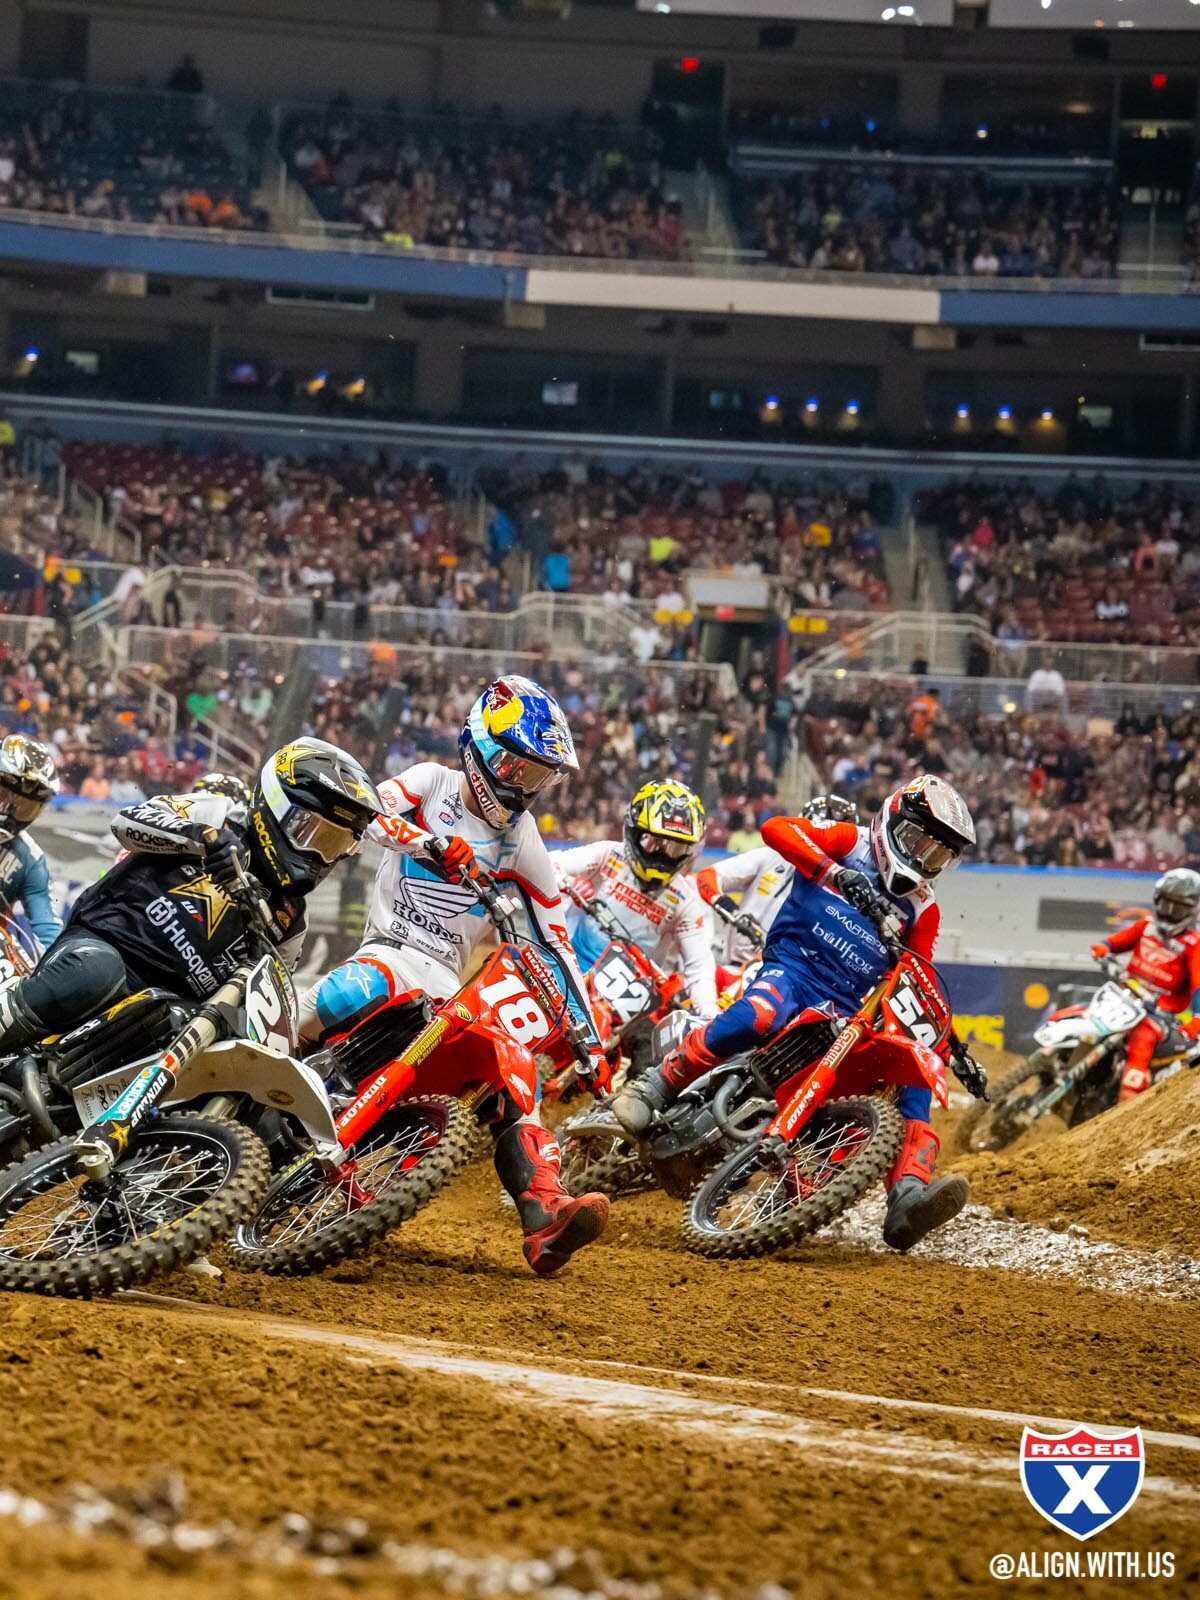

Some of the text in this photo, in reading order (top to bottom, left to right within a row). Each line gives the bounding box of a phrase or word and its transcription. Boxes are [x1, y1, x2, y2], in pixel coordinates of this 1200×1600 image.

[393, 900, 464, 945] HONDA
[609, 890, 663, 926] RACING
[615, 881, 667, 918] MOOSE
[524, 951, 560, 1001] RENTHAL
[593, 956, 652, 1021] 52
[910, 956, 950, 1019] RENTHAL
[479, 973, 550, 1046] 18
[888, 985, 938, 1049] 54
[131, 1071, 169, 1129] DUNLOP
[340, 1074, 389, 1128] DUNLOP
[786, 1087, 816, 1131] DUNLOP
